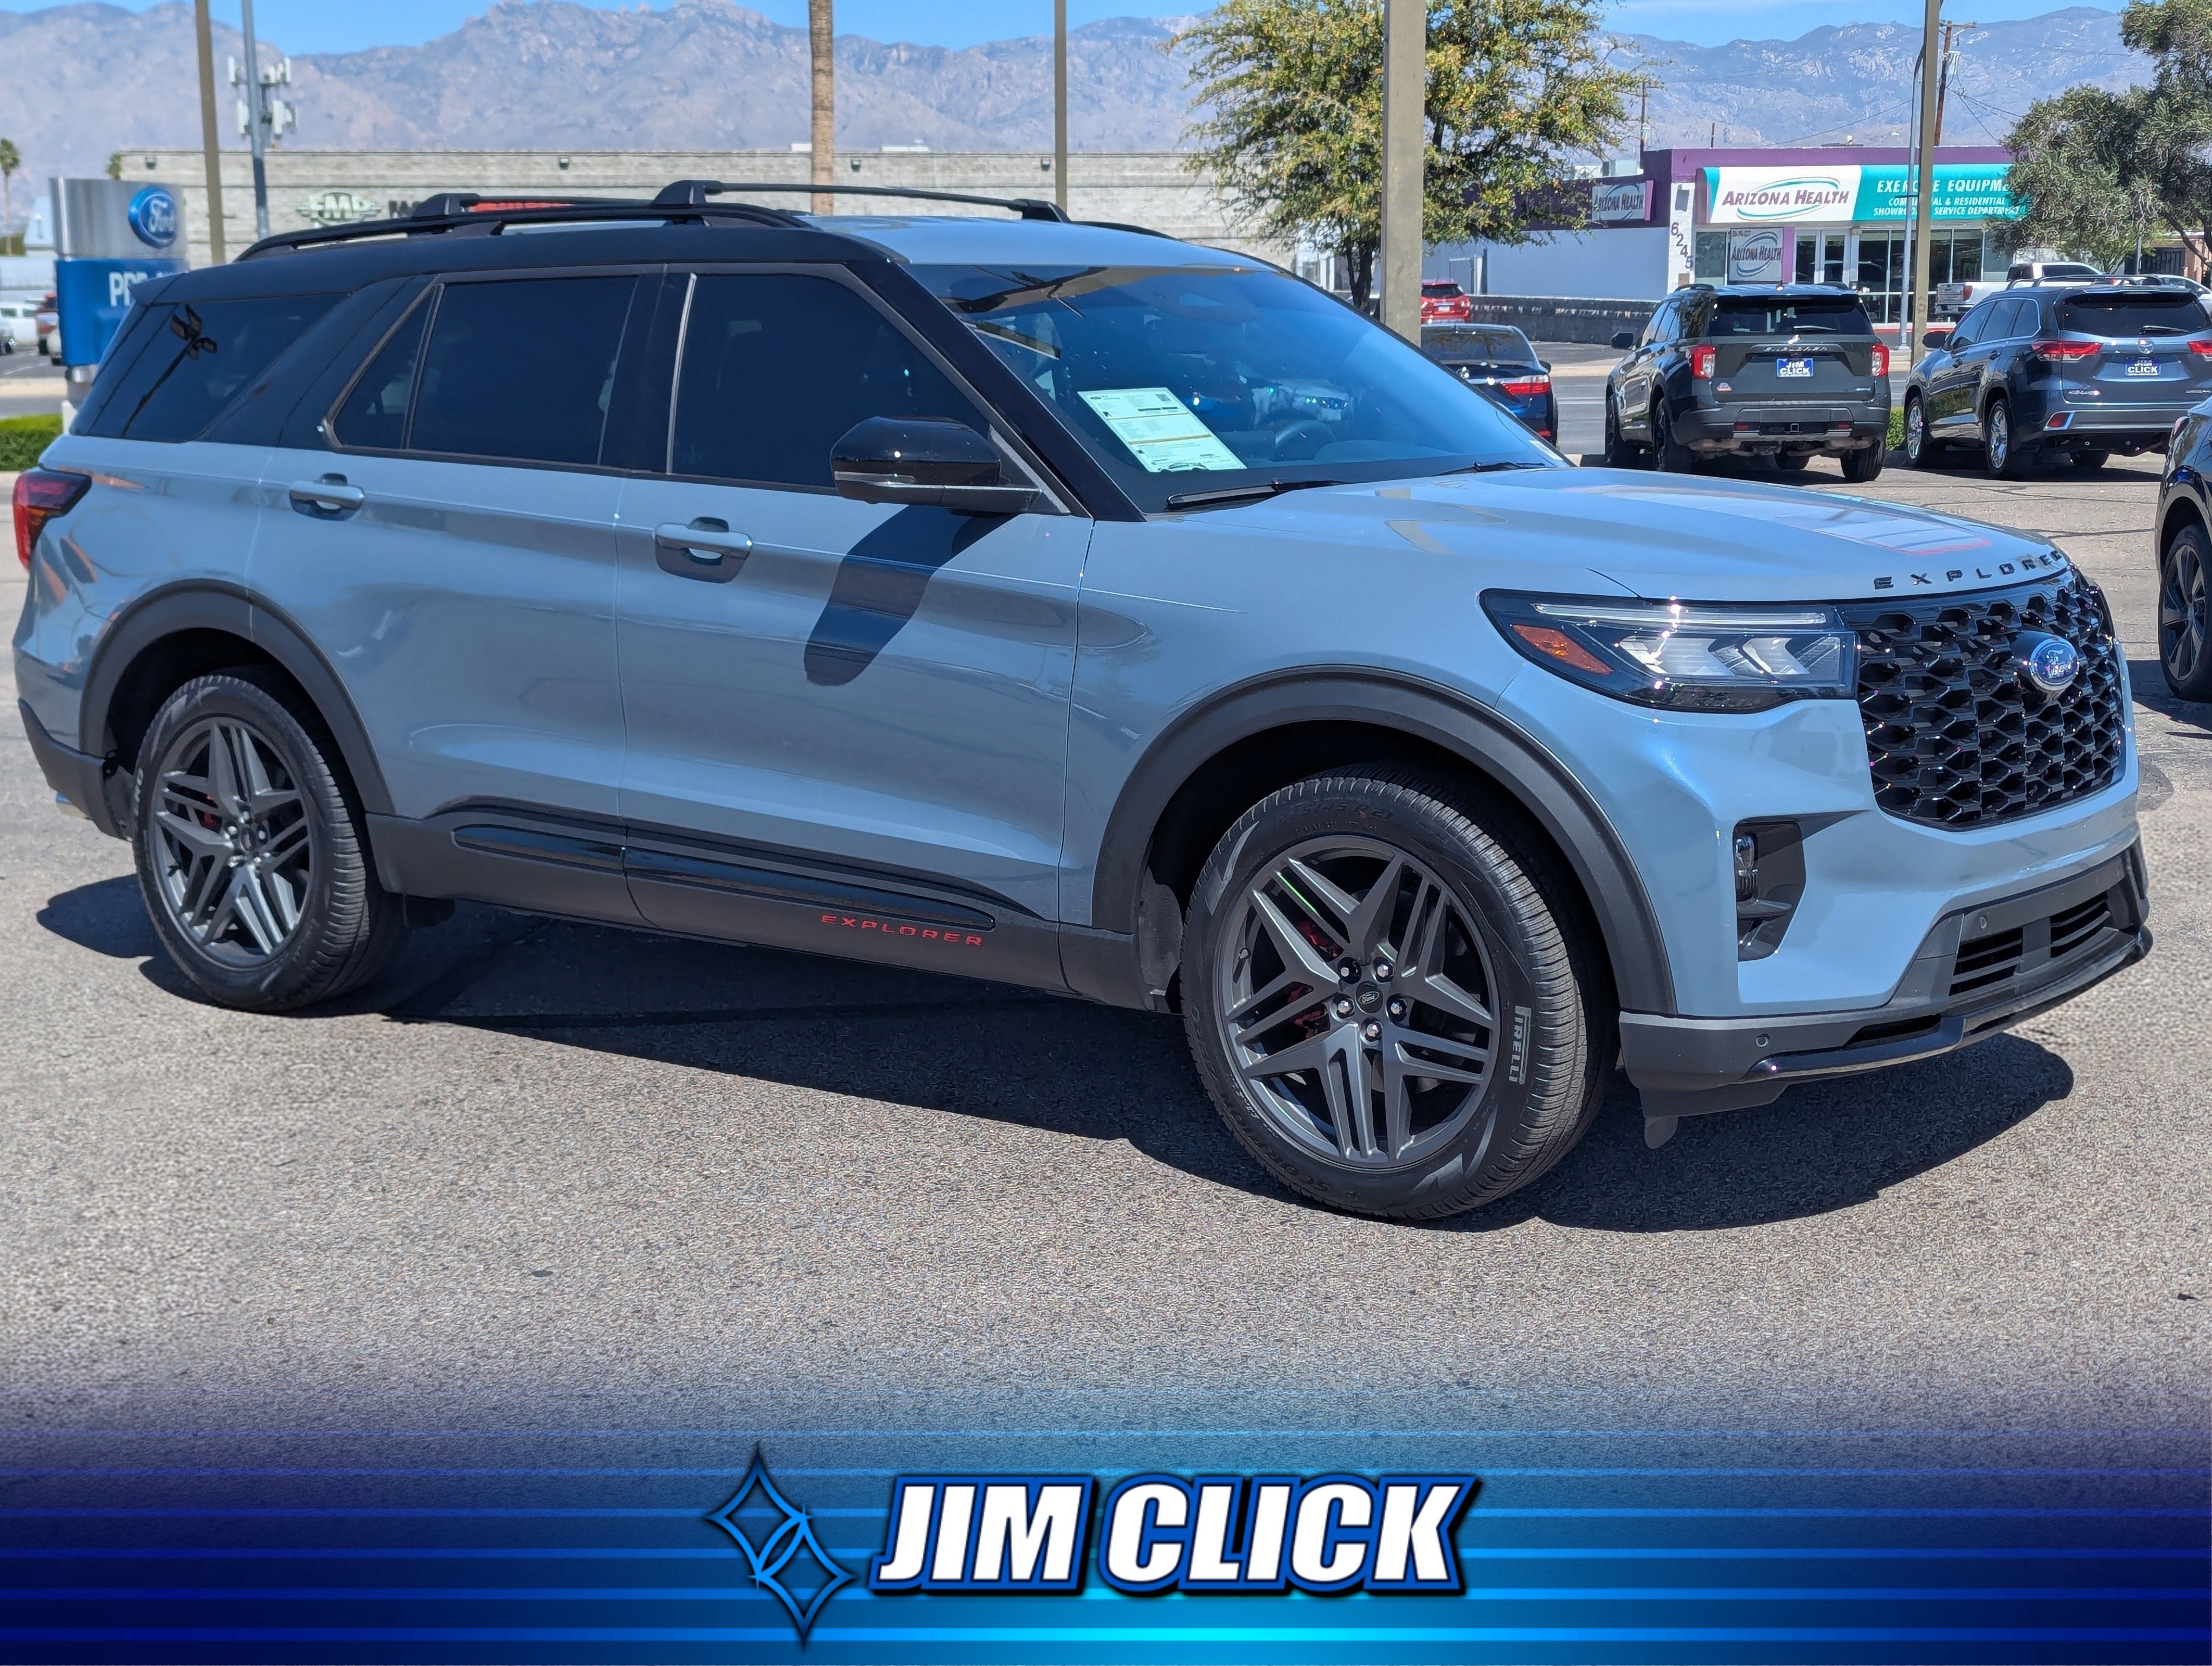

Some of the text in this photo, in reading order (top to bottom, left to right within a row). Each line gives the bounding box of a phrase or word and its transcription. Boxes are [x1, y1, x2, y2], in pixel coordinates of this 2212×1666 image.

[1721, 190, 1850, 206] ARIZONA HEALTH
[1954, 197, 2006, 206] RESIDENTIAL
[1933, 207, 1966, 215] SERVICE
[1671, 221, 1694, 270] 6245
[820, 914, 983, 946] EXPLORER
[1508, 1005, 1532, 1085] PIRELLI
